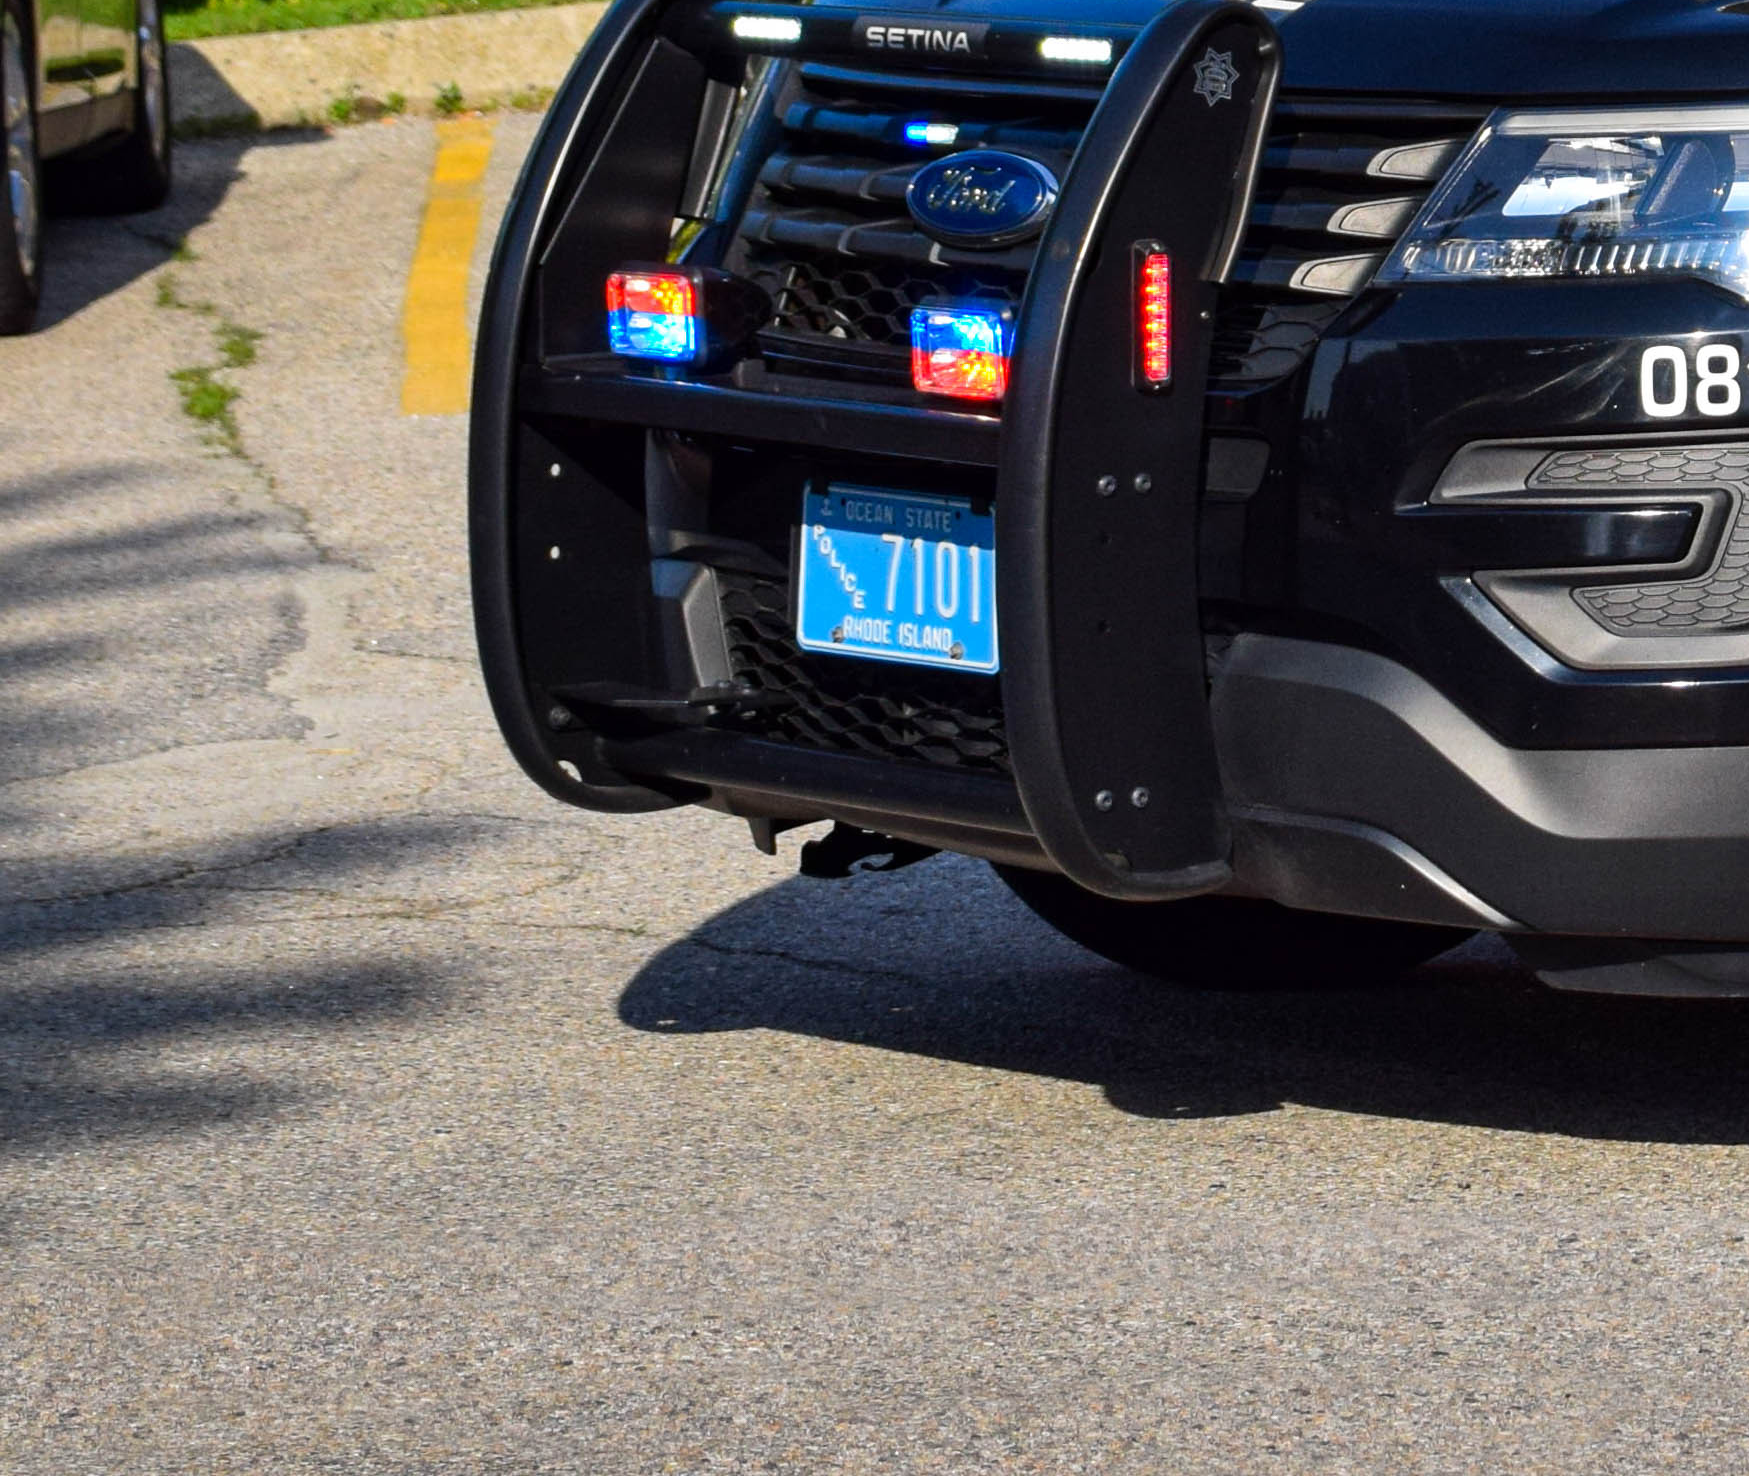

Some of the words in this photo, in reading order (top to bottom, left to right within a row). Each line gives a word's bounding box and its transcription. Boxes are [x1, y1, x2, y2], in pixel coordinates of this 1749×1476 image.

[866, 26, 971, 52] SETINA
[926, 166, 1017, 214] Ford
[845, 500, 894, 524] OCEAN
[906, 508, 951, 532] STATE
[813, 525, 866, 610] POLICE
[881, 532, 980, 623] 7101
[843, 615, 893, 645] RHODE
[899, 623, 952, 653] ISLAND
